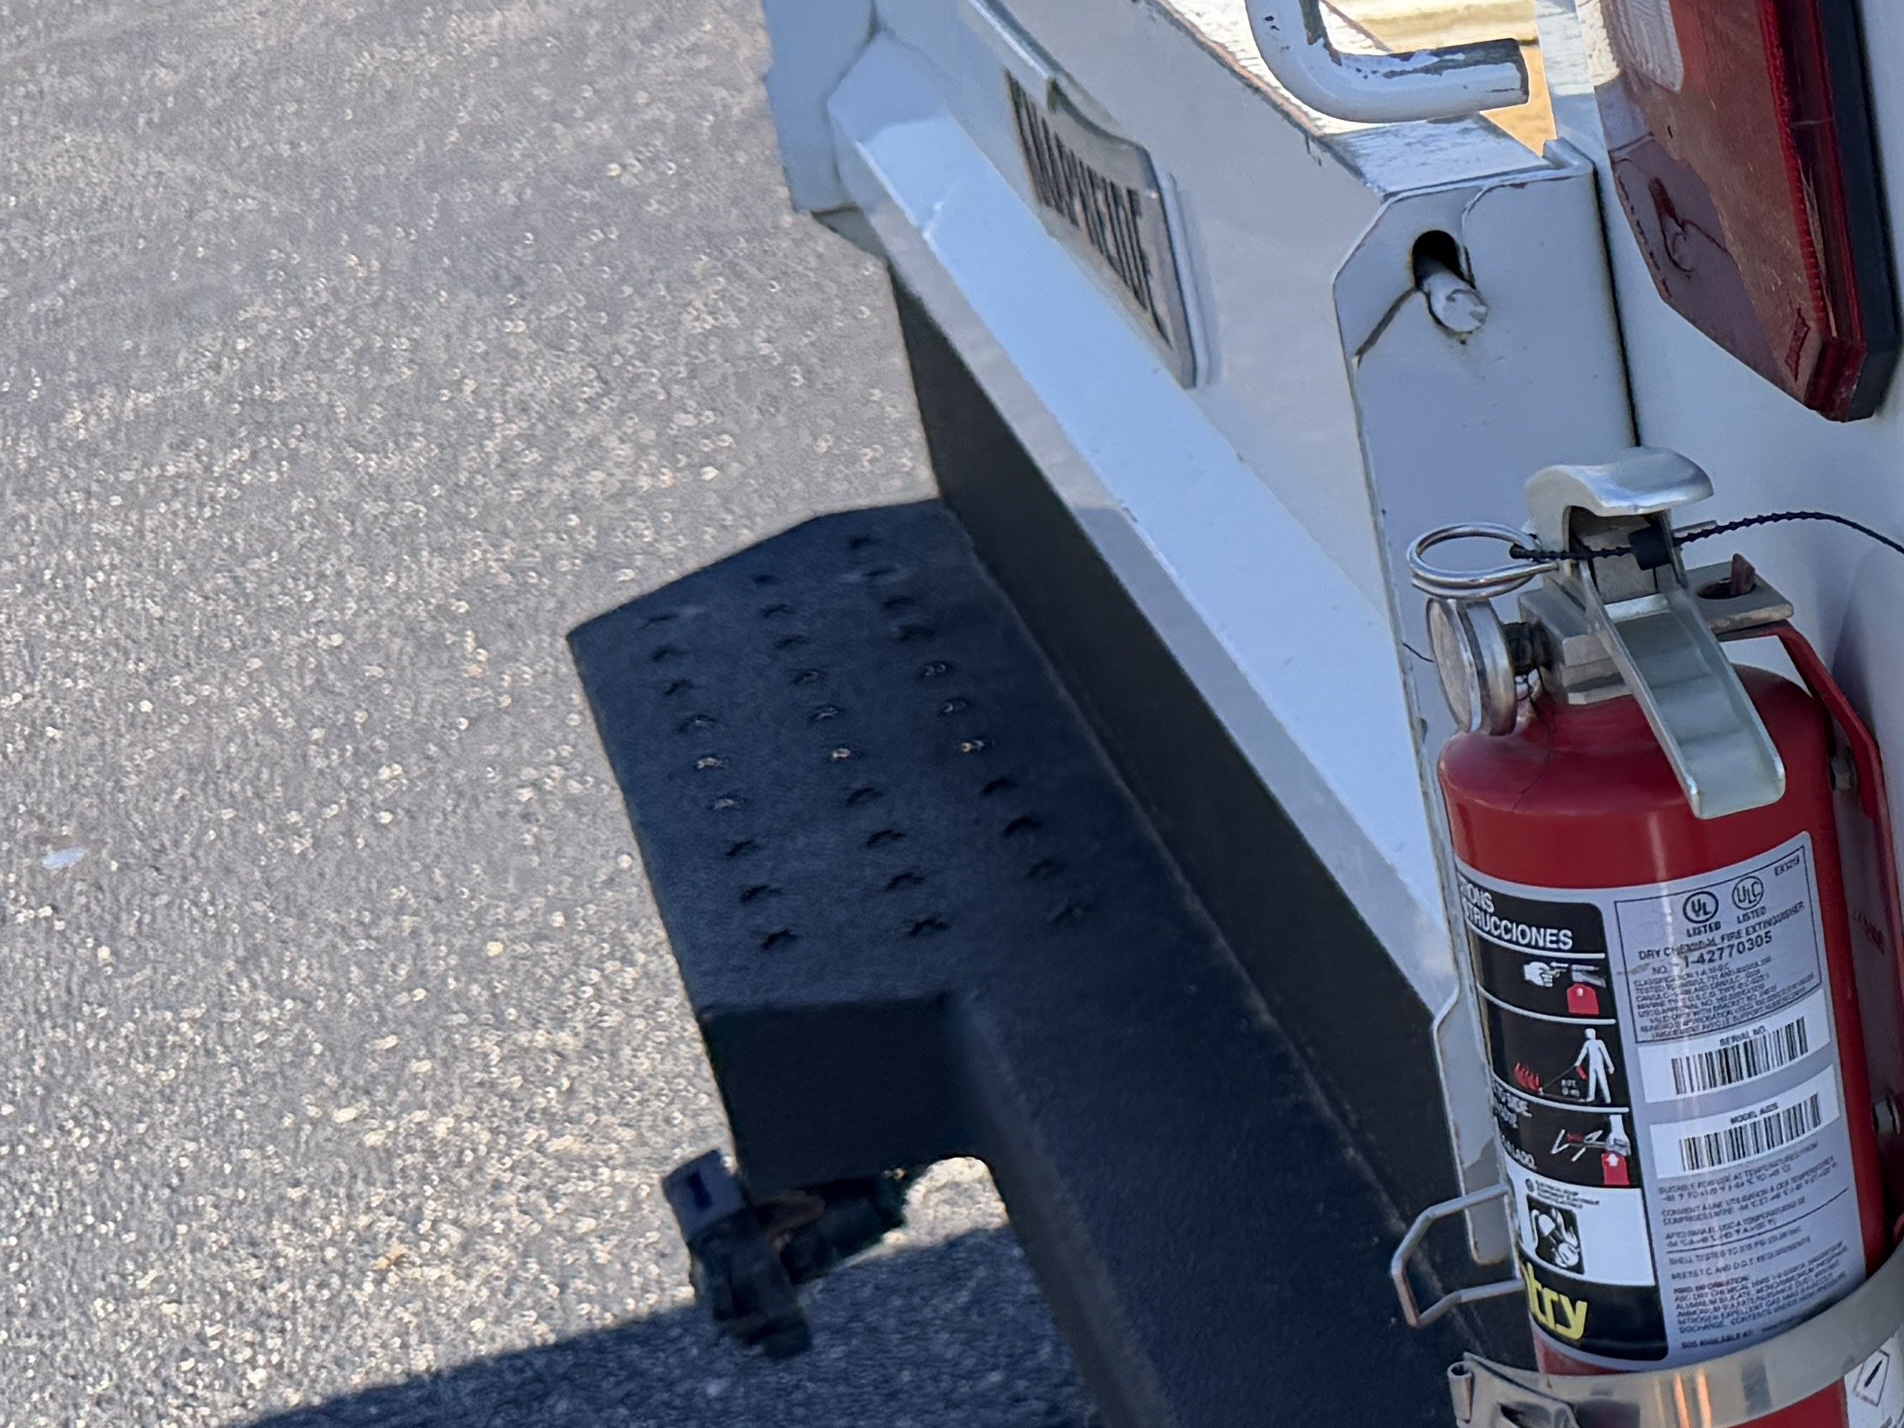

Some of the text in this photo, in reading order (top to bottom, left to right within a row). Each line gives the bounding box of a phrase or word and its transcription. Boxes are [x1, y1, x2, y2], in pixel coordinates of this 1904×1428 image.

[1736, 904, 1766, 925] LISTED
[1638, 949, 1661, 960] DRY
[1720, 928, 1743, 943] FIRE
[1745, 899, 1804, 937] EXTINGUISHER
[1686, 920, 1721, 937] LISTED
